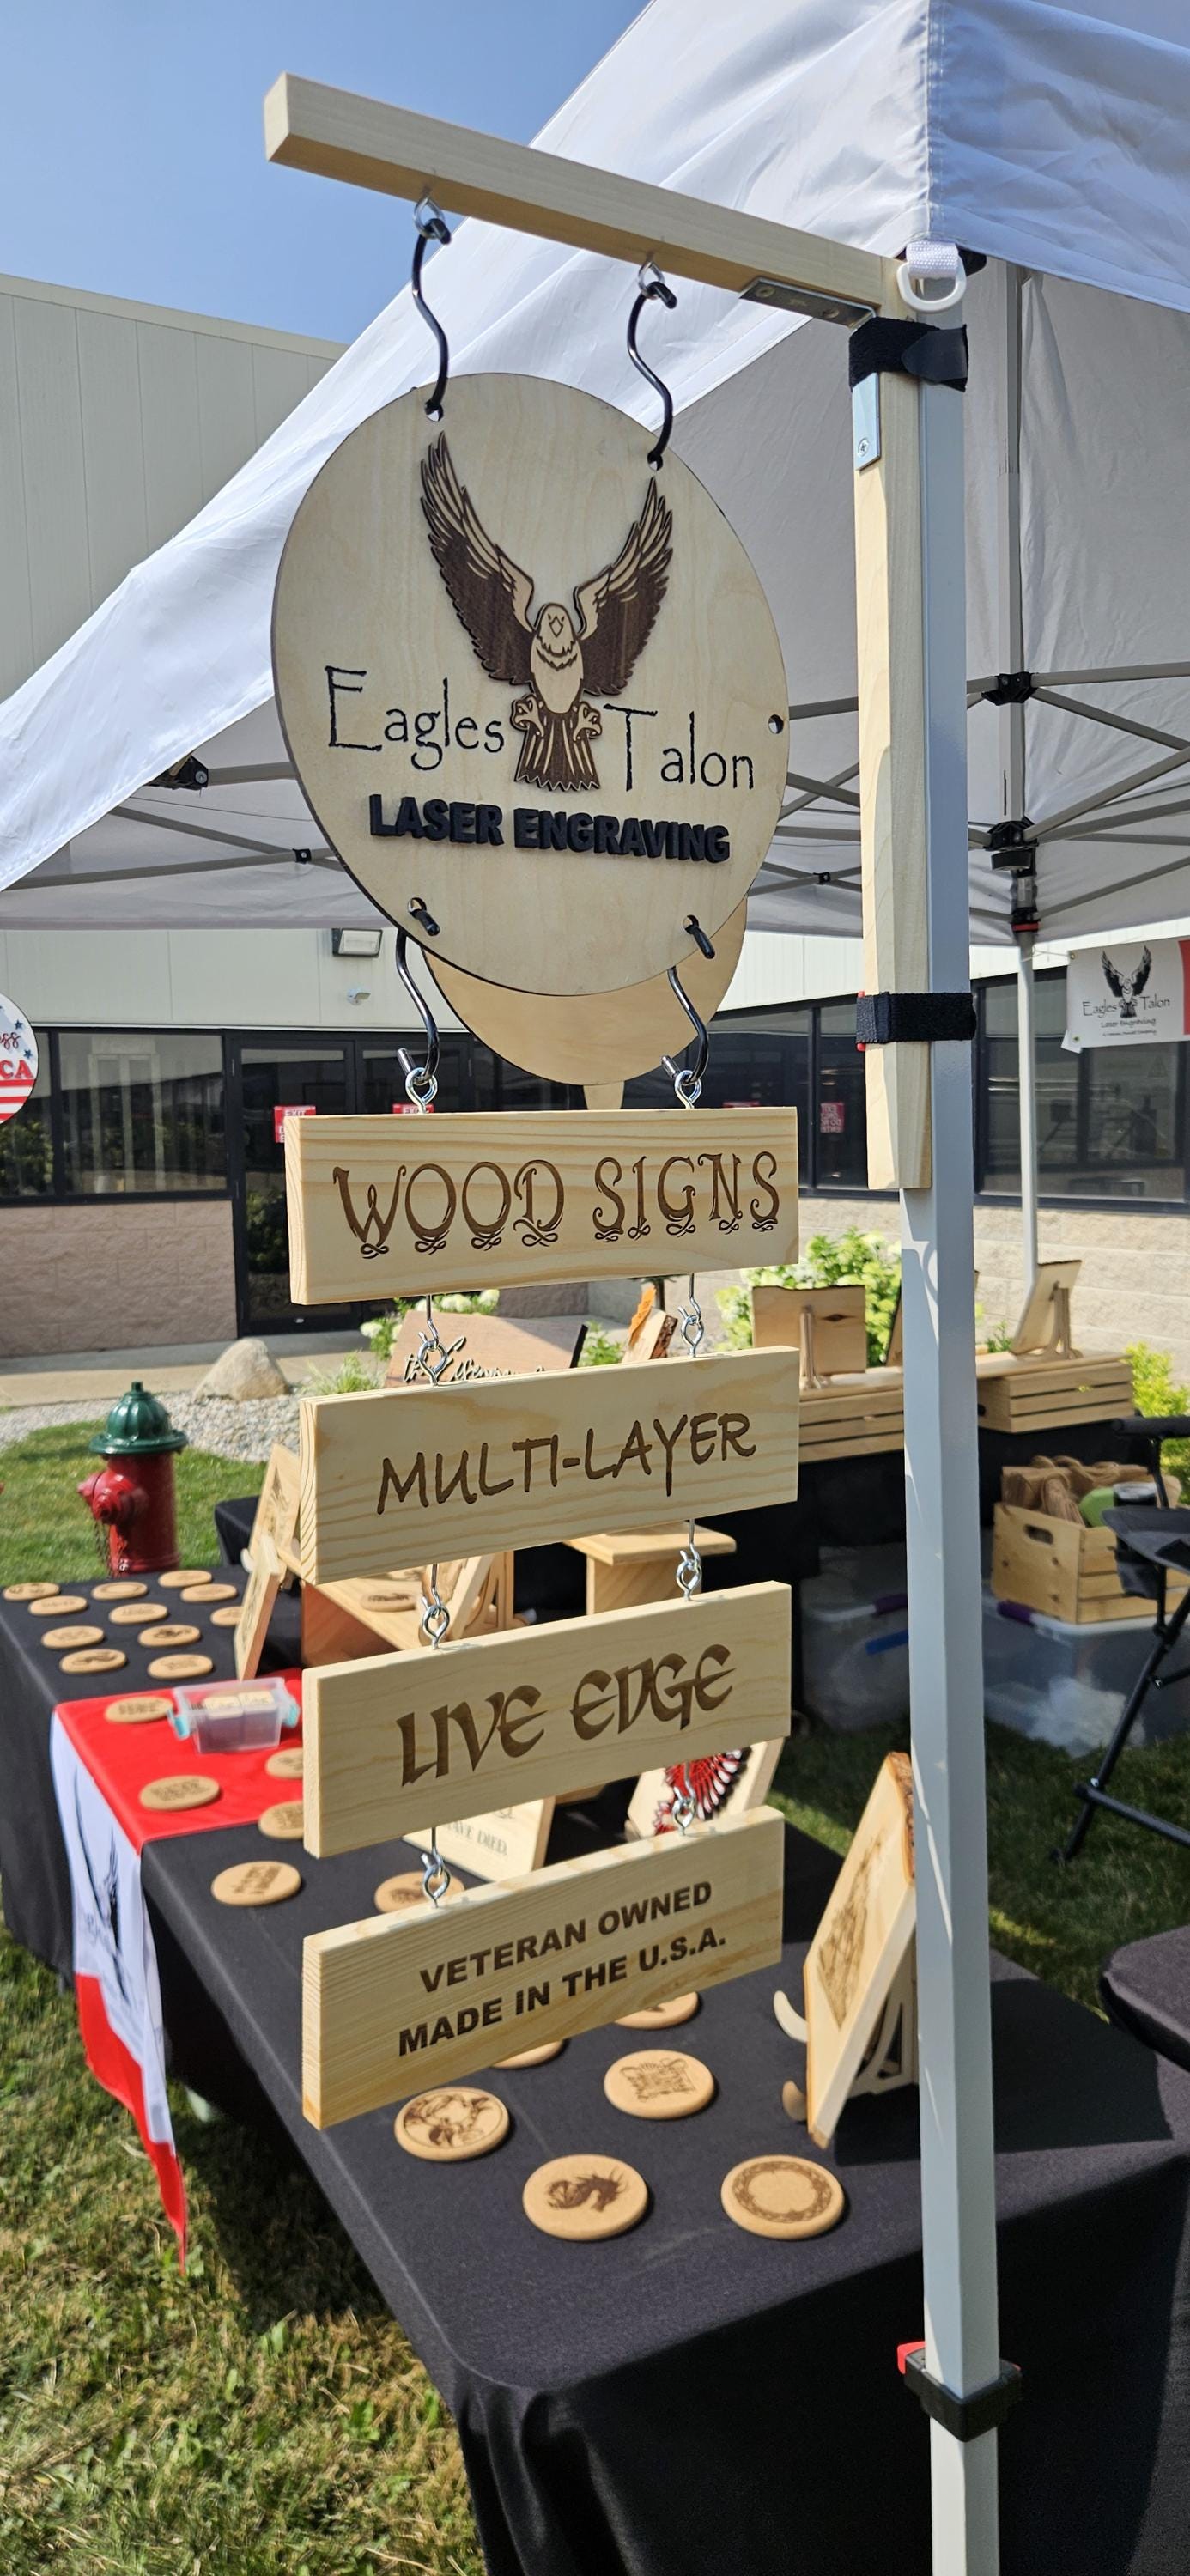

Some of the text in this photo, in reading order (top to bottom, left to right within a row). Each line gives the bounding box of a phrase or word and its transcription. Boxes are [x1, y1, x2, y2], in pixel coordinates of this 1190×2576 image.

[325, 665, 756, 792] Eagles Talon
[368, 793, 731, 864] LASER ENGRAVING
[1082, 993, 1171, 1018] Eagles Talon
[332, 1151, 780, 1259] WOOD SIGNS
[376, 1412, 757, 1515] MULTI-LAYER
[395, 1643, 737, 1787] LIVE EDGE
[398, 1926, 726, 2057] MADE IN THE U.S.A.
[419, 1880, 713, 1993] VETERAN OWNED
